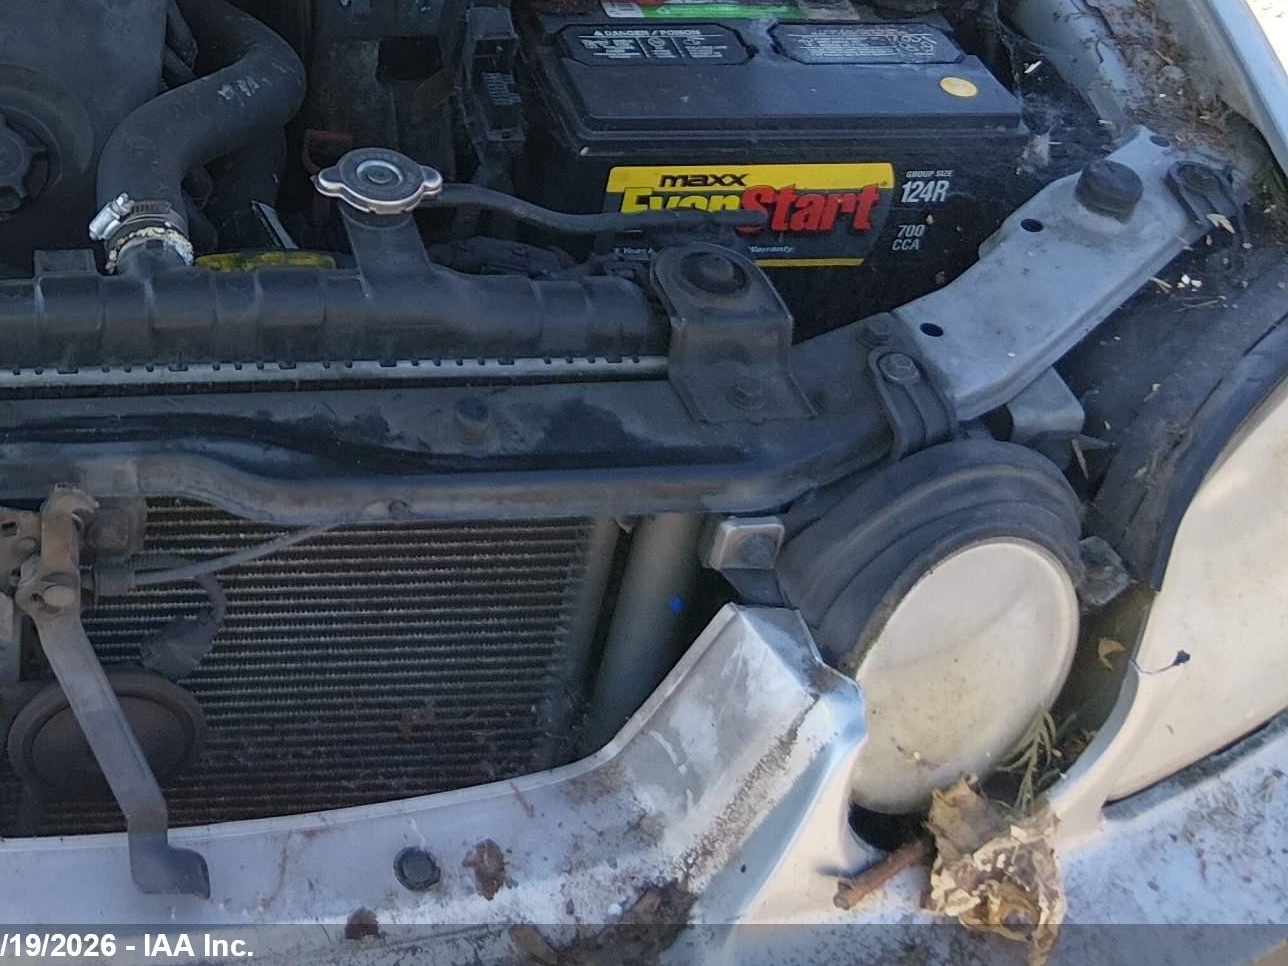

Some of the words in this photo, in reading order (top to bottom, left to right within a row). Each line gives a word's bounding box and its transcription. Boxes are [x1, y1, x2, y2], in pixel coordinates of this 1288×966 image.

[659, 173, 749, 187] maxx
[905, 170, 934, 178] GROUP
[934, 169, 953, 178] SIZE
[900, 179, 950, 203] 124R
[896, 224, 925, 238] 700
[891, 238, 920, 251] CCA
